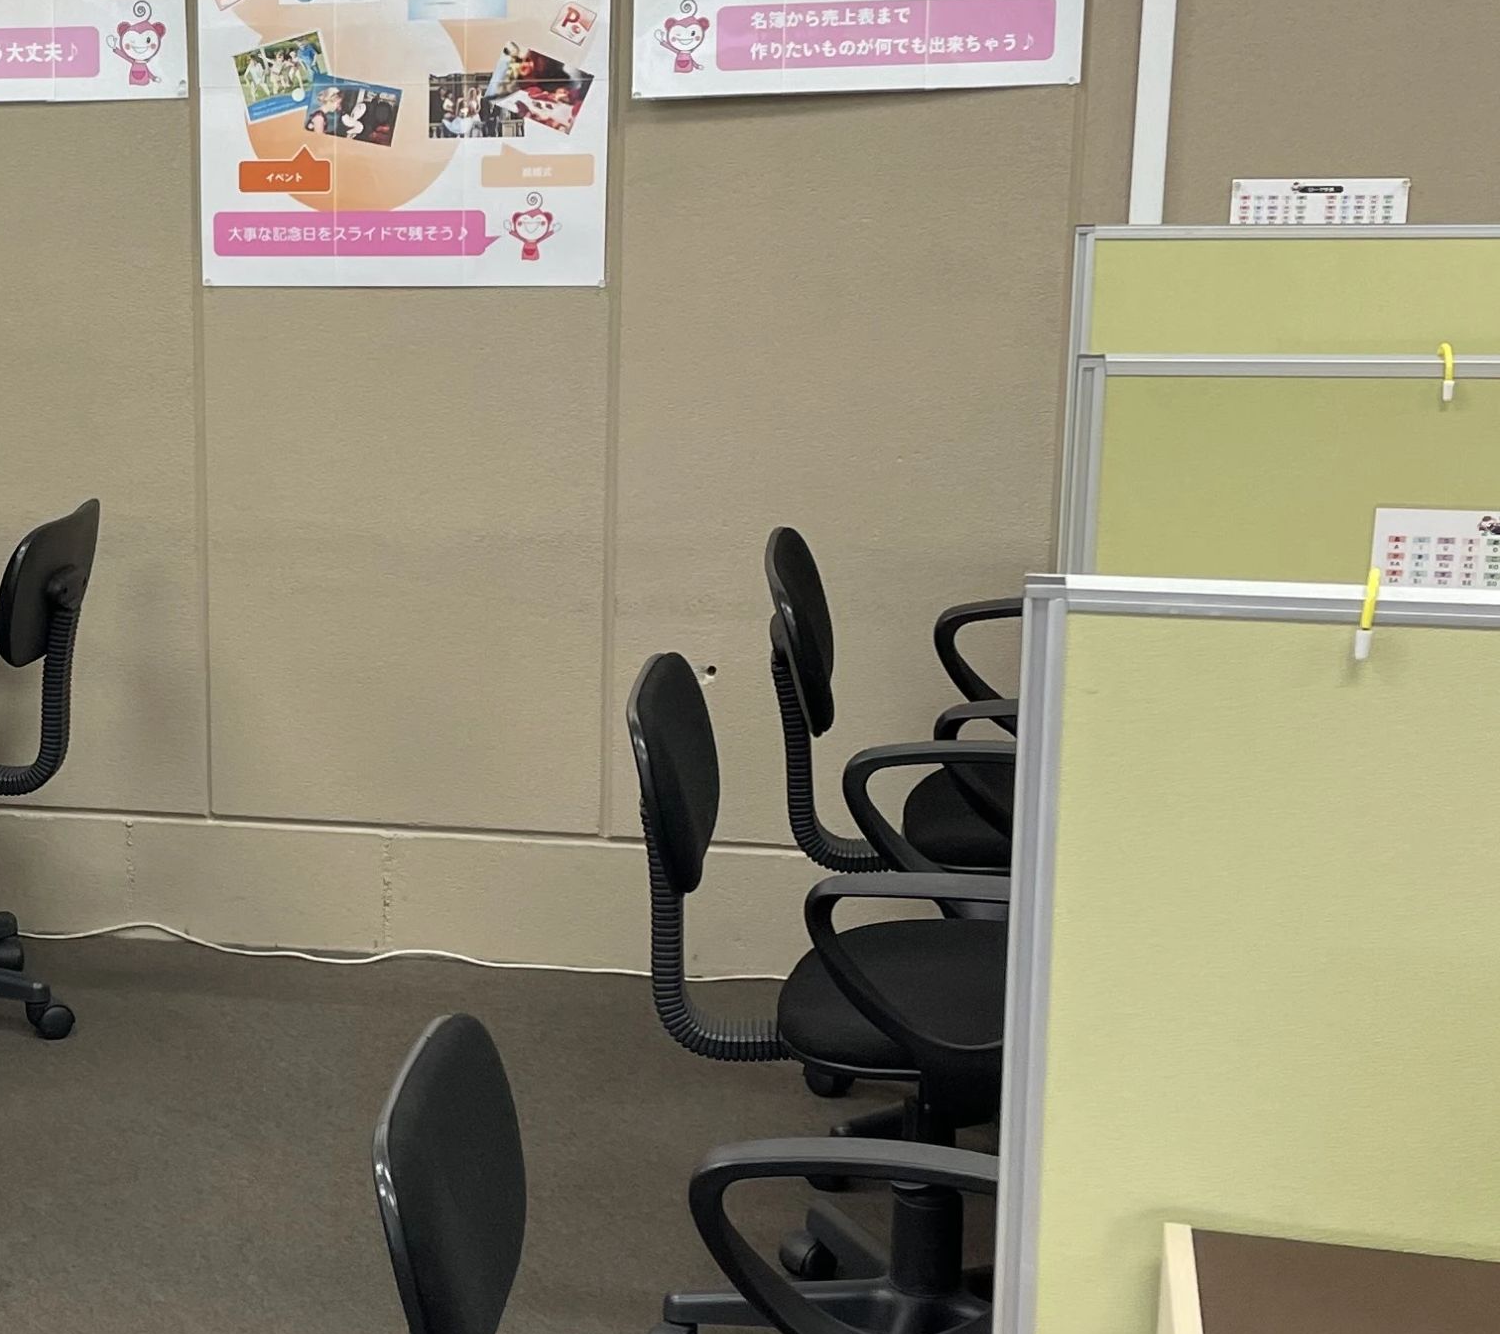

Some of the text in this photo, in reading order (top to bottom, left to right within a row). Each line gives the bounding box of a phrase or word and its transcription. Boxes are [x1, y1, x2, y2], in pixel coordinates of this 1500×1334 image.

[750, 6, 910, 30] 名簿から売上表まで
[750, 33, 1016, 61] 作りたいものが何でも出来ちゃう
[265, 172, 303, 184] イベント
[228, 224, 455, 244] 大事な記念日をスライドで残そう
